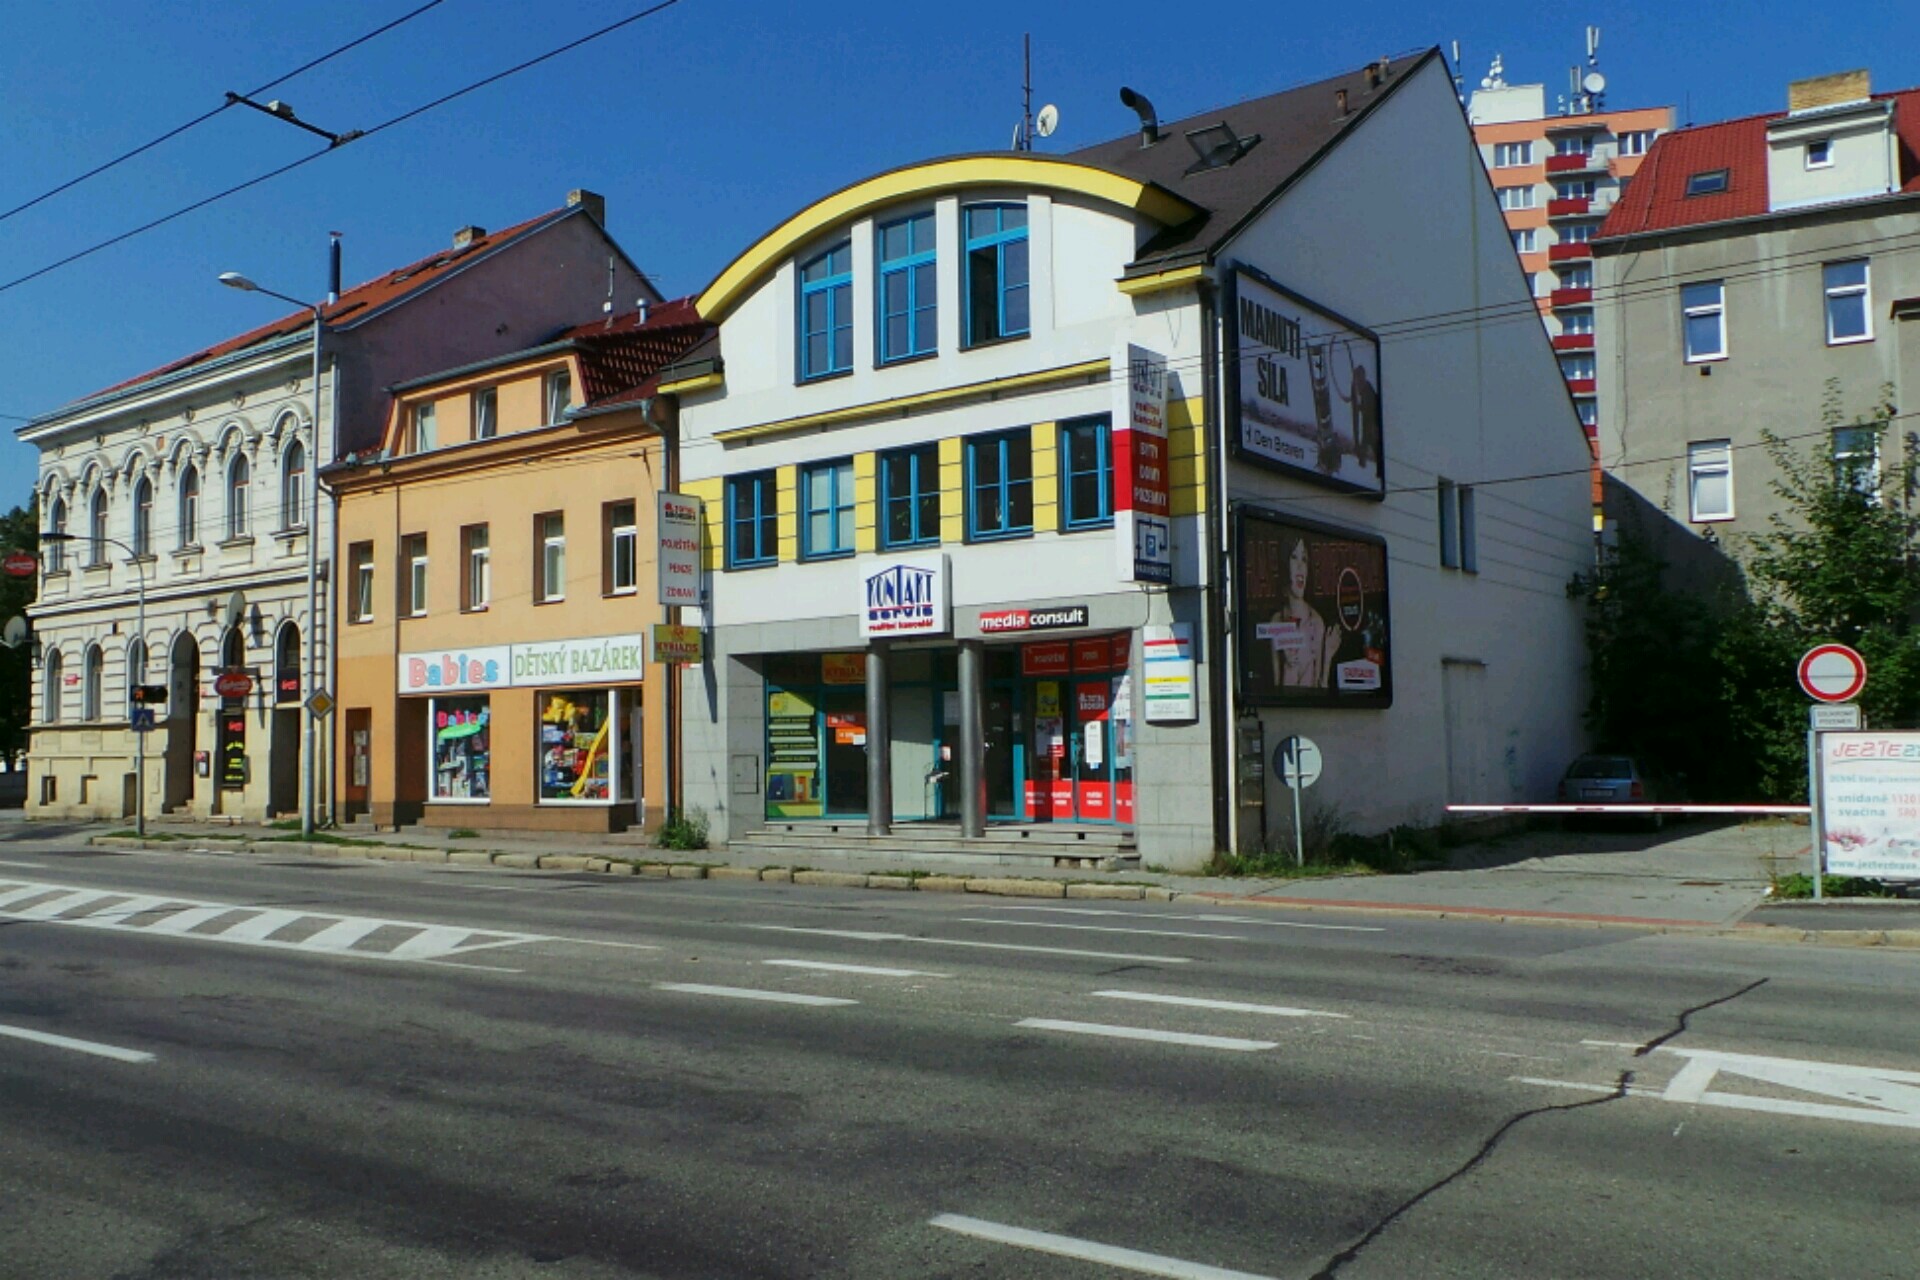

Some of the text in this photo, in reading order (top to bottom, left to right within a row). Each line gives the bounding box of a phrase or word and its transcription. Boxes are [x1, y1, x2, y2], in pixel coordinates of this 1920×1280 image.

[1240, 296, 1301, 360] MAMUTÍ
[1257, 353, 1289, 407] SÍLA
[668, 562, 693, 575] PENZE
[666, 586, 696, 598] ZDRAVÍ
[980, 608, 1084, 629] media consult
[408, 640, 640, 688] Babies DĚTSKÝ BAZÁREK
[436, 709, 489, 728] Babies
[1838, 807, 1886, 817] svačina
